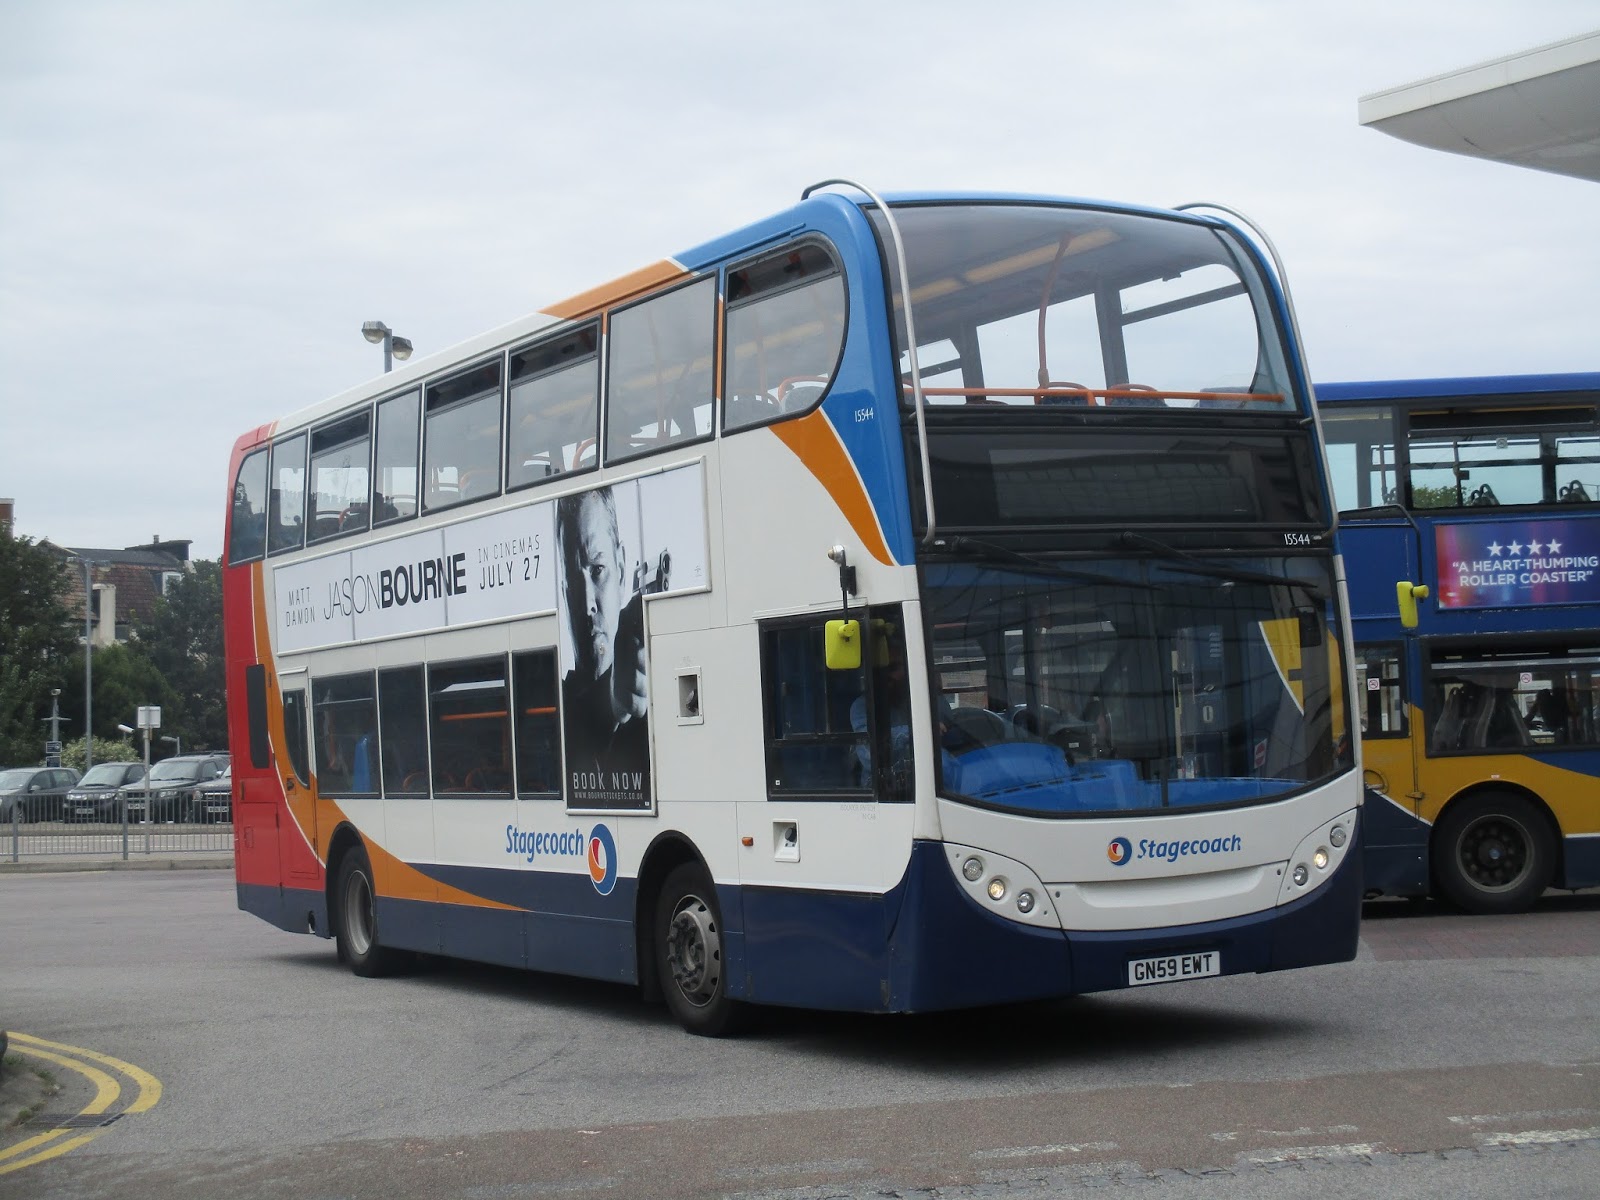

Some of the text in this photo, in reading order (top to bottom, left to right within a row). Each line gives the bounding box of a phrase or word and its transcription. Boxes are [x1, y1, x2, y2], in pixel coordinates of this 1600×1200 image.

[854, 407, 874, 422] 15544
[478, 534, 540, 564] IN CINEMAS
[1284, 533, 1310, 545] 15544
[479, 555, 541, 590] JULY 27
[1473, 556, 1599, 572] HEART-THUMPING
[1459, 573, 1516, 587] ROLLER
[288, 586, 311, 606] MATT
[286, 606, 315, 627] DAMON
[573, 772, 642, 790] BOOK NOW
[506, 824, 584, 863] Stagecoach
[1137, 834, 1241, 863] Stagecoach
[1134, 954, 1213, 981] GN59 EWT
